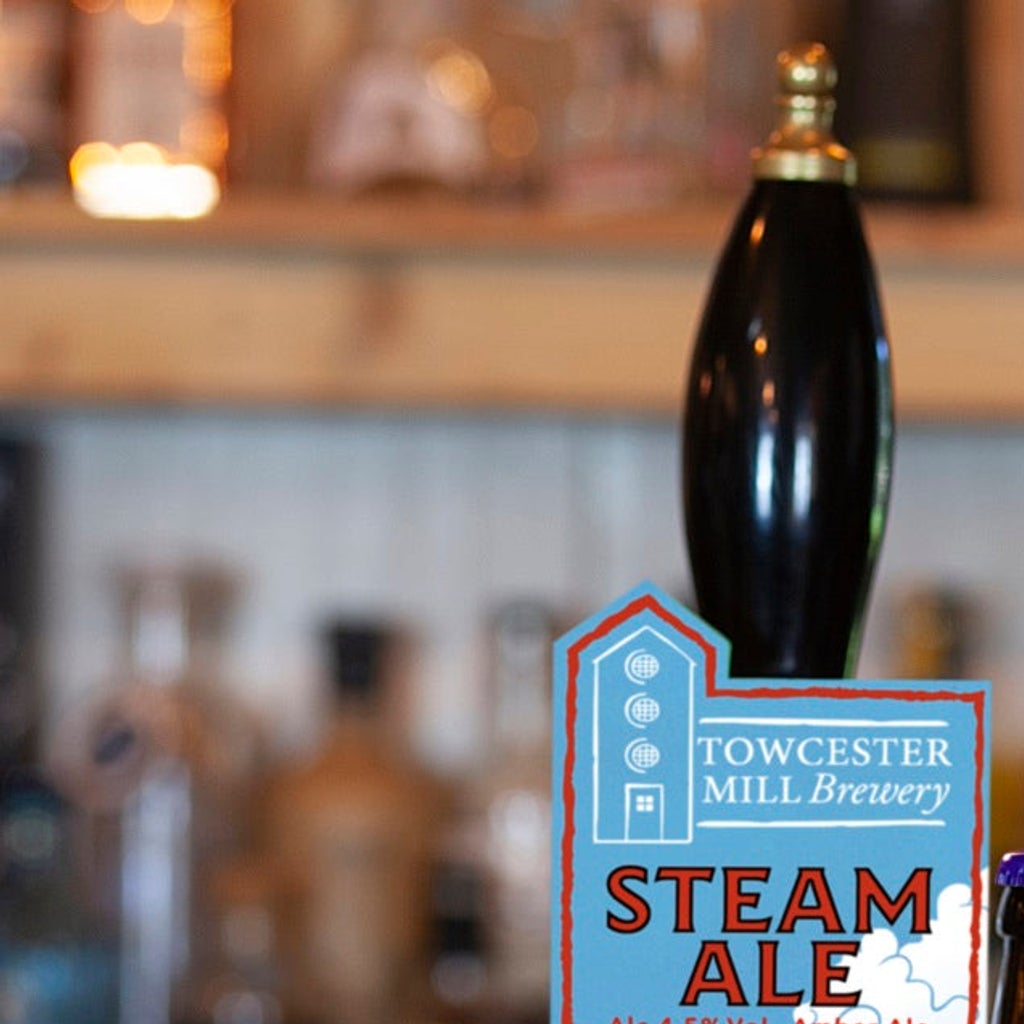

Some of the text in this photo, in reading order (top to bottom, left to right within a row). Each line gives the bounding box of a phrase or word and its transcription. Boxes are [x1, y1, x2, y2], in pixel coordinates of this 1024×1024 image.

[697, 737, 952, 767] TOWCESTER
[702, 773, 951, 815] MILL Brewery
[606, 865, 932, 934] STEAM
[680, 940, 862, 1006] ALE
